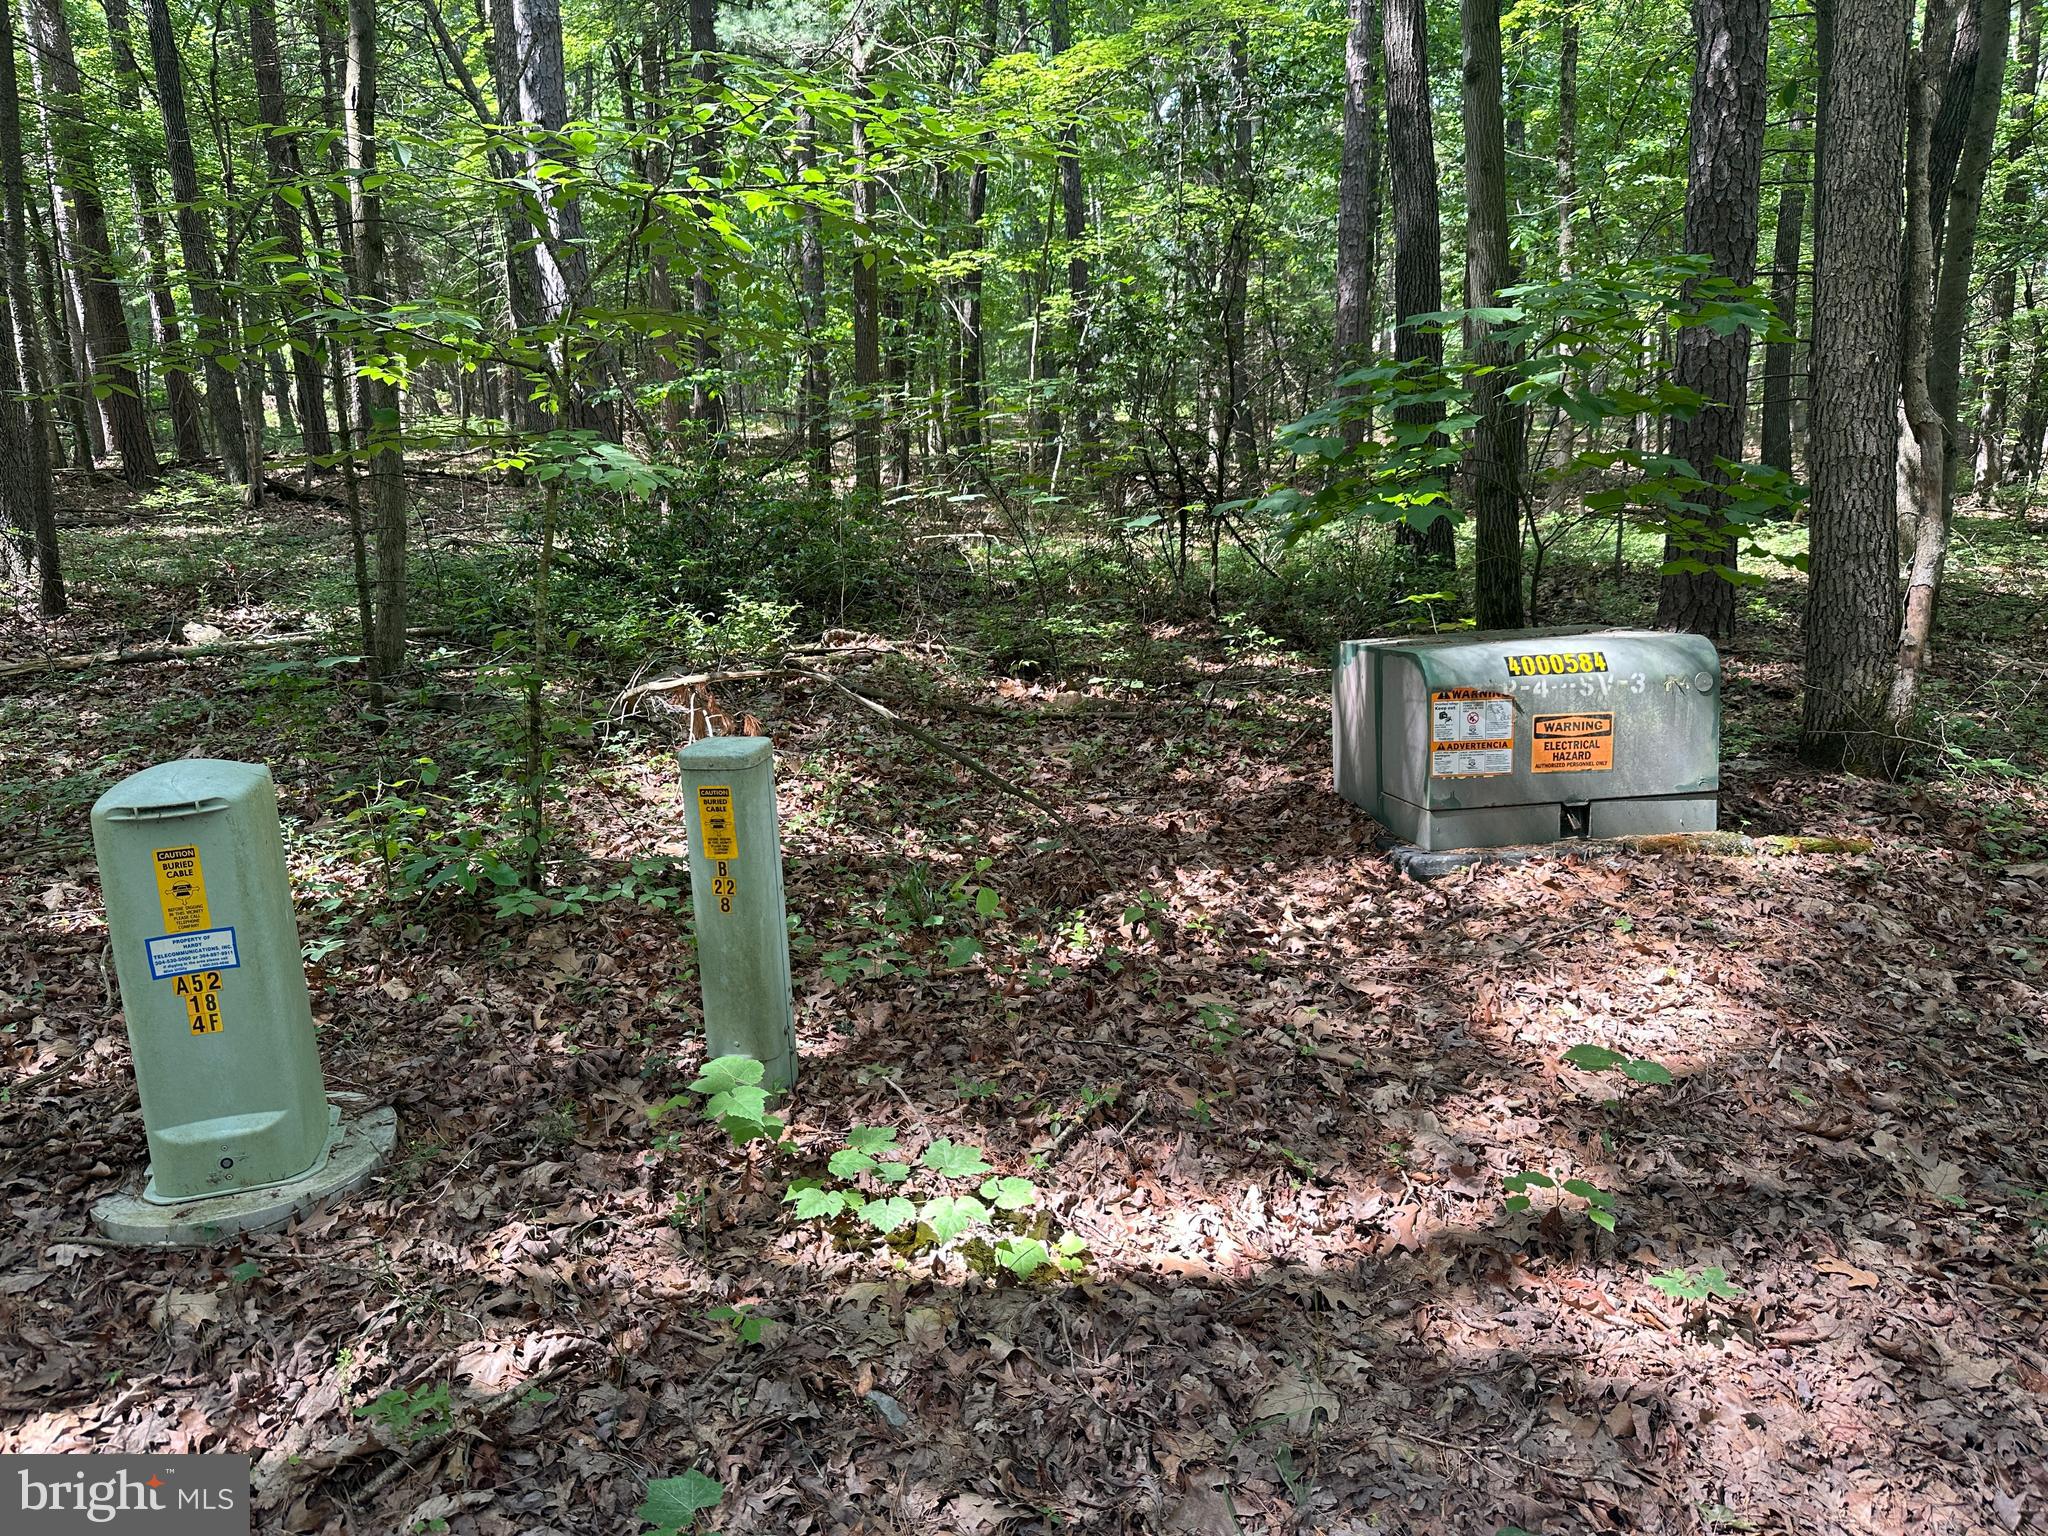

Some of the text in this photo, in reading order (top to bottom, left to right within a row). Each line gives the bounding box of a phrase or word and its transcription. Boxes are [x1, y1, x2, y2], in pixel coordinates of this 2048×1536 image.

[1508, 652, 1606, 675] 4000584
[1544, 721, 1603, 732] WARNING
[1446, 742, 1508, 750] ADVERTENCIA
[1544, 740, 1600, 750] ELECTRICAL
[1552, 751, 1591, 761] HAZARD
[158, 850, 194, 860] CAUTION
[162, 860, 193, 870] BURIED
[718, 862, 727, 876] B
[166, 869, 193, 878] CABLE
[715, 879, 734, 894] 22
[721, 897, 730, 912] 8
[176, 972, 221, 995] A52
[190, 994, 216, 1013] 18
[192, 1014, 218, 1032] 4F
